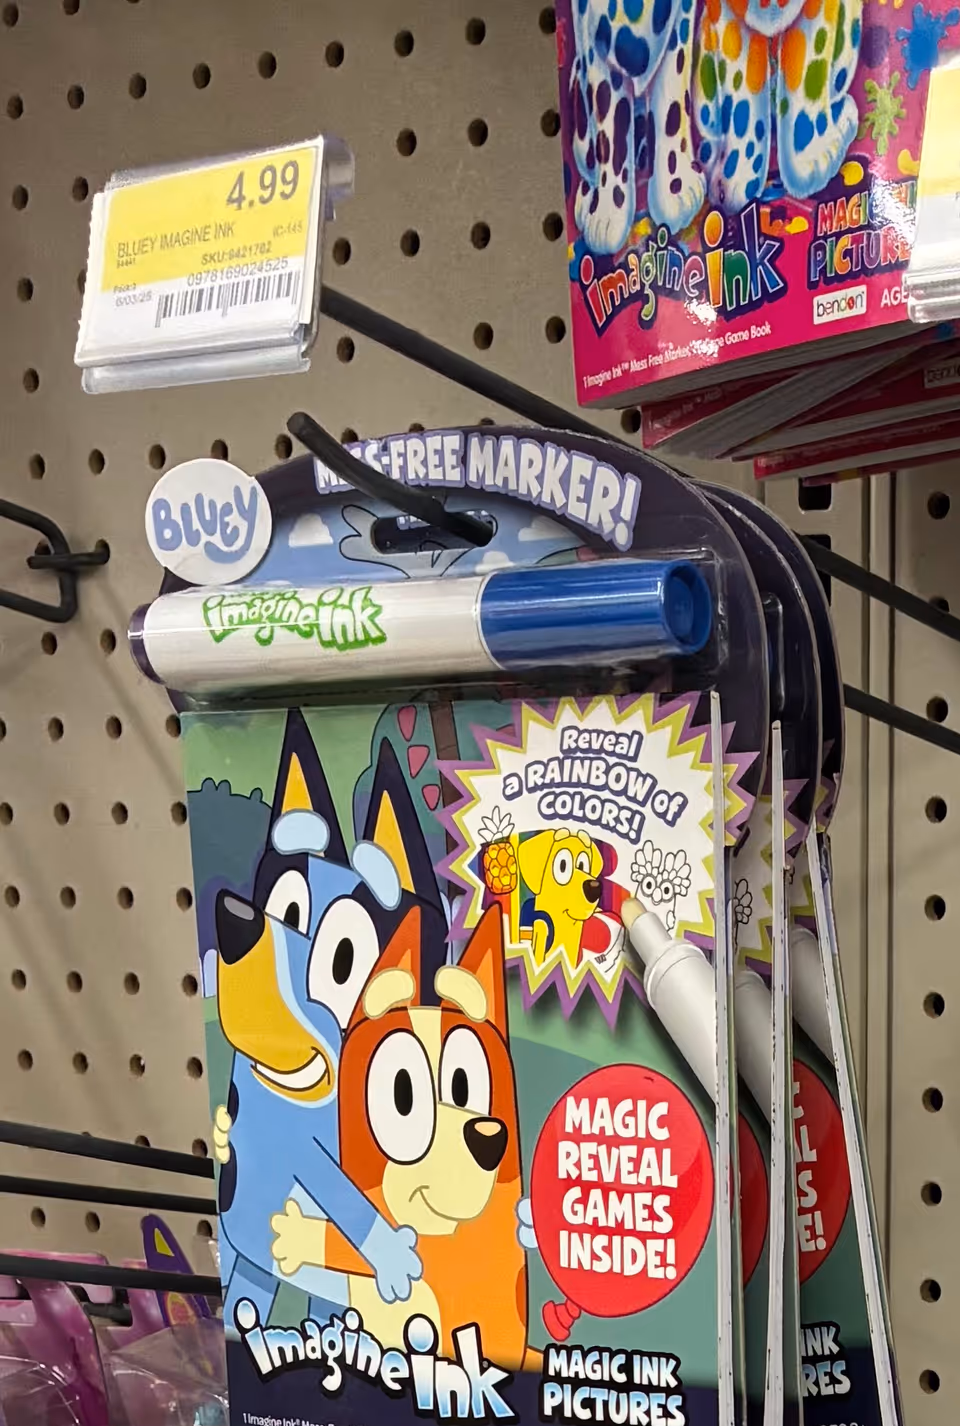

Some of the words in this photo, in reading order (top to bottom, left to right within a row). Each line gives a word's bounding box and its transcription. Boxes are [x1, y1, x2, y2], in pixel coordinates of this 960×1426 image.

[226, 160, 300, 211] 4.99
[118, 238, 156, 258] BLUEY
[160, 225, 211, 250] IMAGINE
[214, 222, 235, 239] INK
[811, 226, 911, 281] PICTURE
[188, 256, 288, 287] 0978169024525
[817, 291, 864, 317] bendon
[470, 437, 640, 546] MARKER!
[152, 486, 258, 563] BLUEY
[562, 728, 640, 760] Reveal
[527, 760, 655, 803] RAINBOW
[539, 793, 644, 842] COLORS!
[564, 1096, 670, 1140] MAGIC
[557, 1141, 678, 1188] REVEAL
[562, 1187, 673, 1234] GAMES
[559, 1230, 677, 1280] INSIDE!
[237, 1300, 409, 1392] imagine
[408, 1316, 515, 1418] ink
[548, 1348, 627, 1383] MAGIC
[633, 1353, 679, 1388] INK
